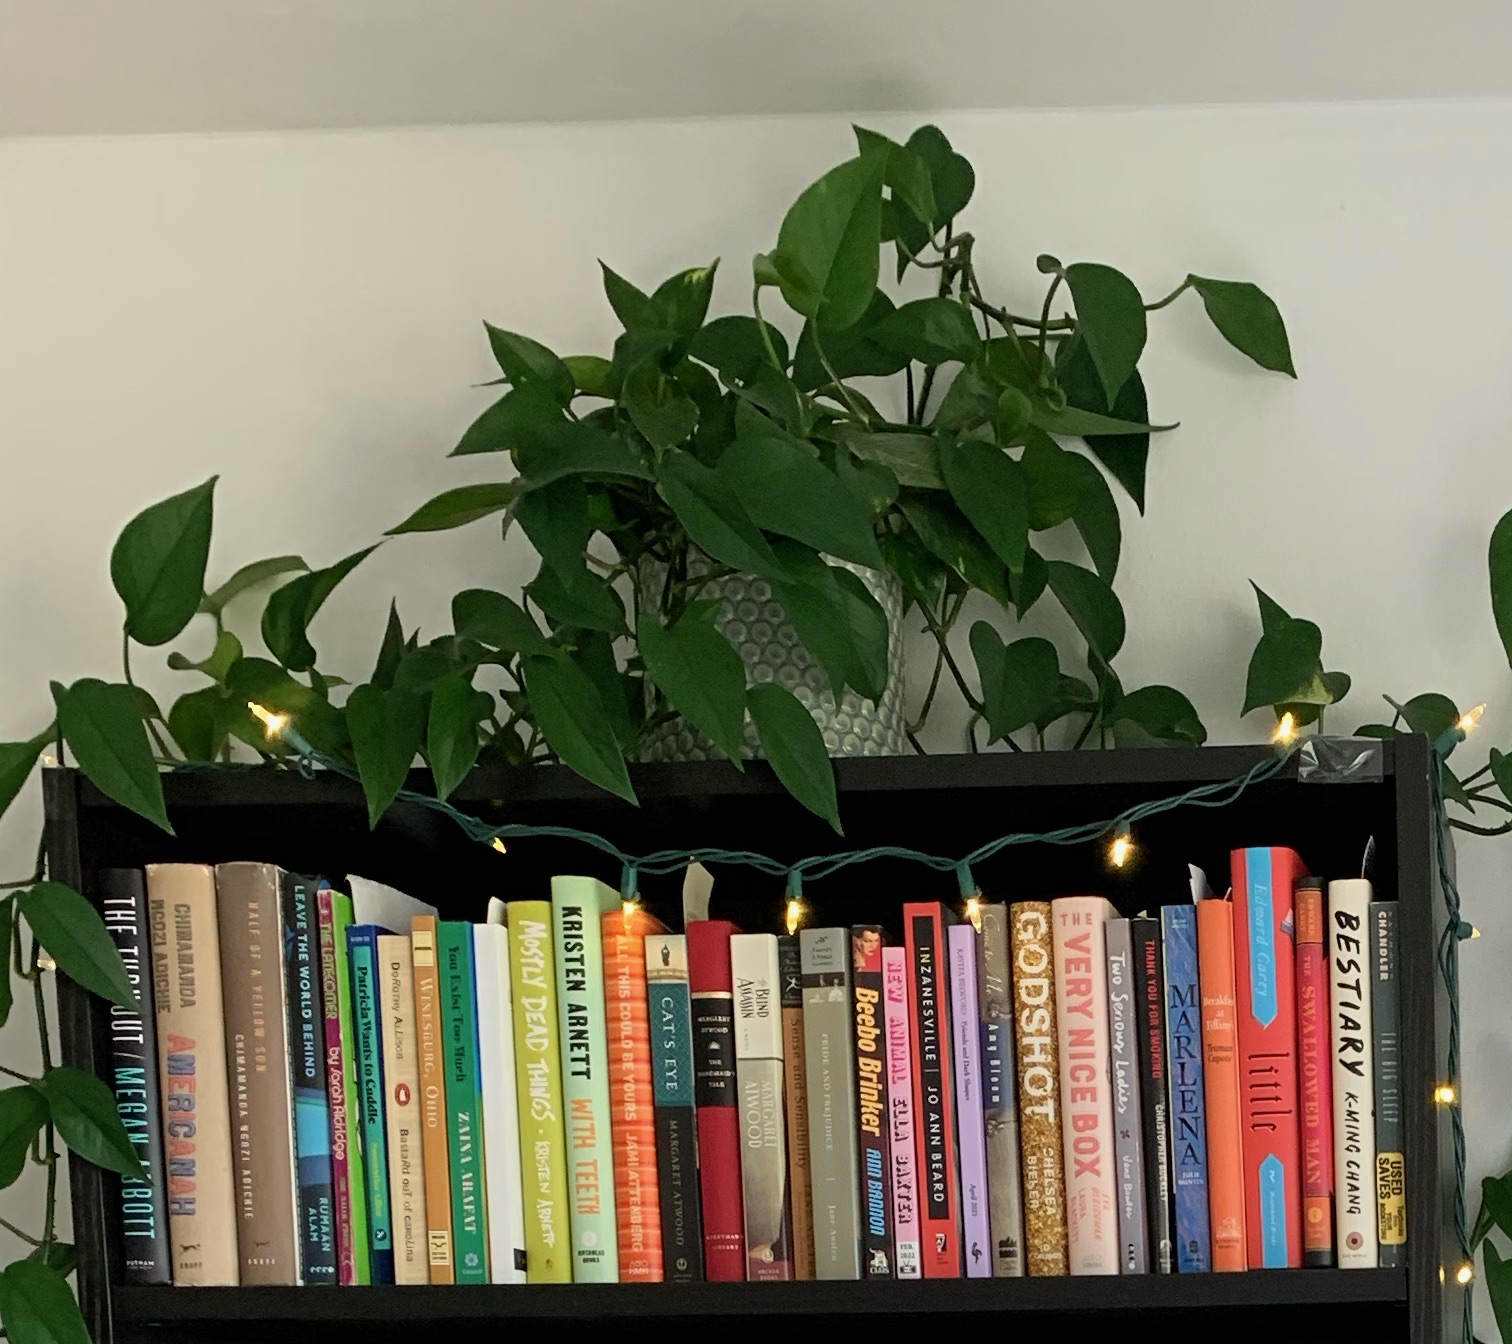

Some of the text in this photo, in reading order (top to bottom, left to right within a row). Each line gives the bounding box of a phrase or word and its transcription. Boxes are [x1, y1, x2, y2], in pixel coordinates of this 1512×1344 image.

[295, 885, 316, 1077] LEAVE THE WORLD BEHIND
[562, 905, 599, 1216] KRISTEN ARNETT WITH TEETH
[855, 987, 882, 1137] Beebo Brinker
[920, 947, 946, 1203] INZANESVILLE JO ANN BEARD
[1016, 911, 1055, 1123] GODSHOT
[1063, 933, 1102, 1179] VERY NICE BOX
[1334, 911, 1366, 1215] BESTIARY K-MING CHANG
[167, 1034, 197, 1216] AMERICANAH
[1248, 1052, 1293, 1133] little
[1378, 1158, 1391, 1199] SAVES
[1390, 1160, 1402, 1195] USED
